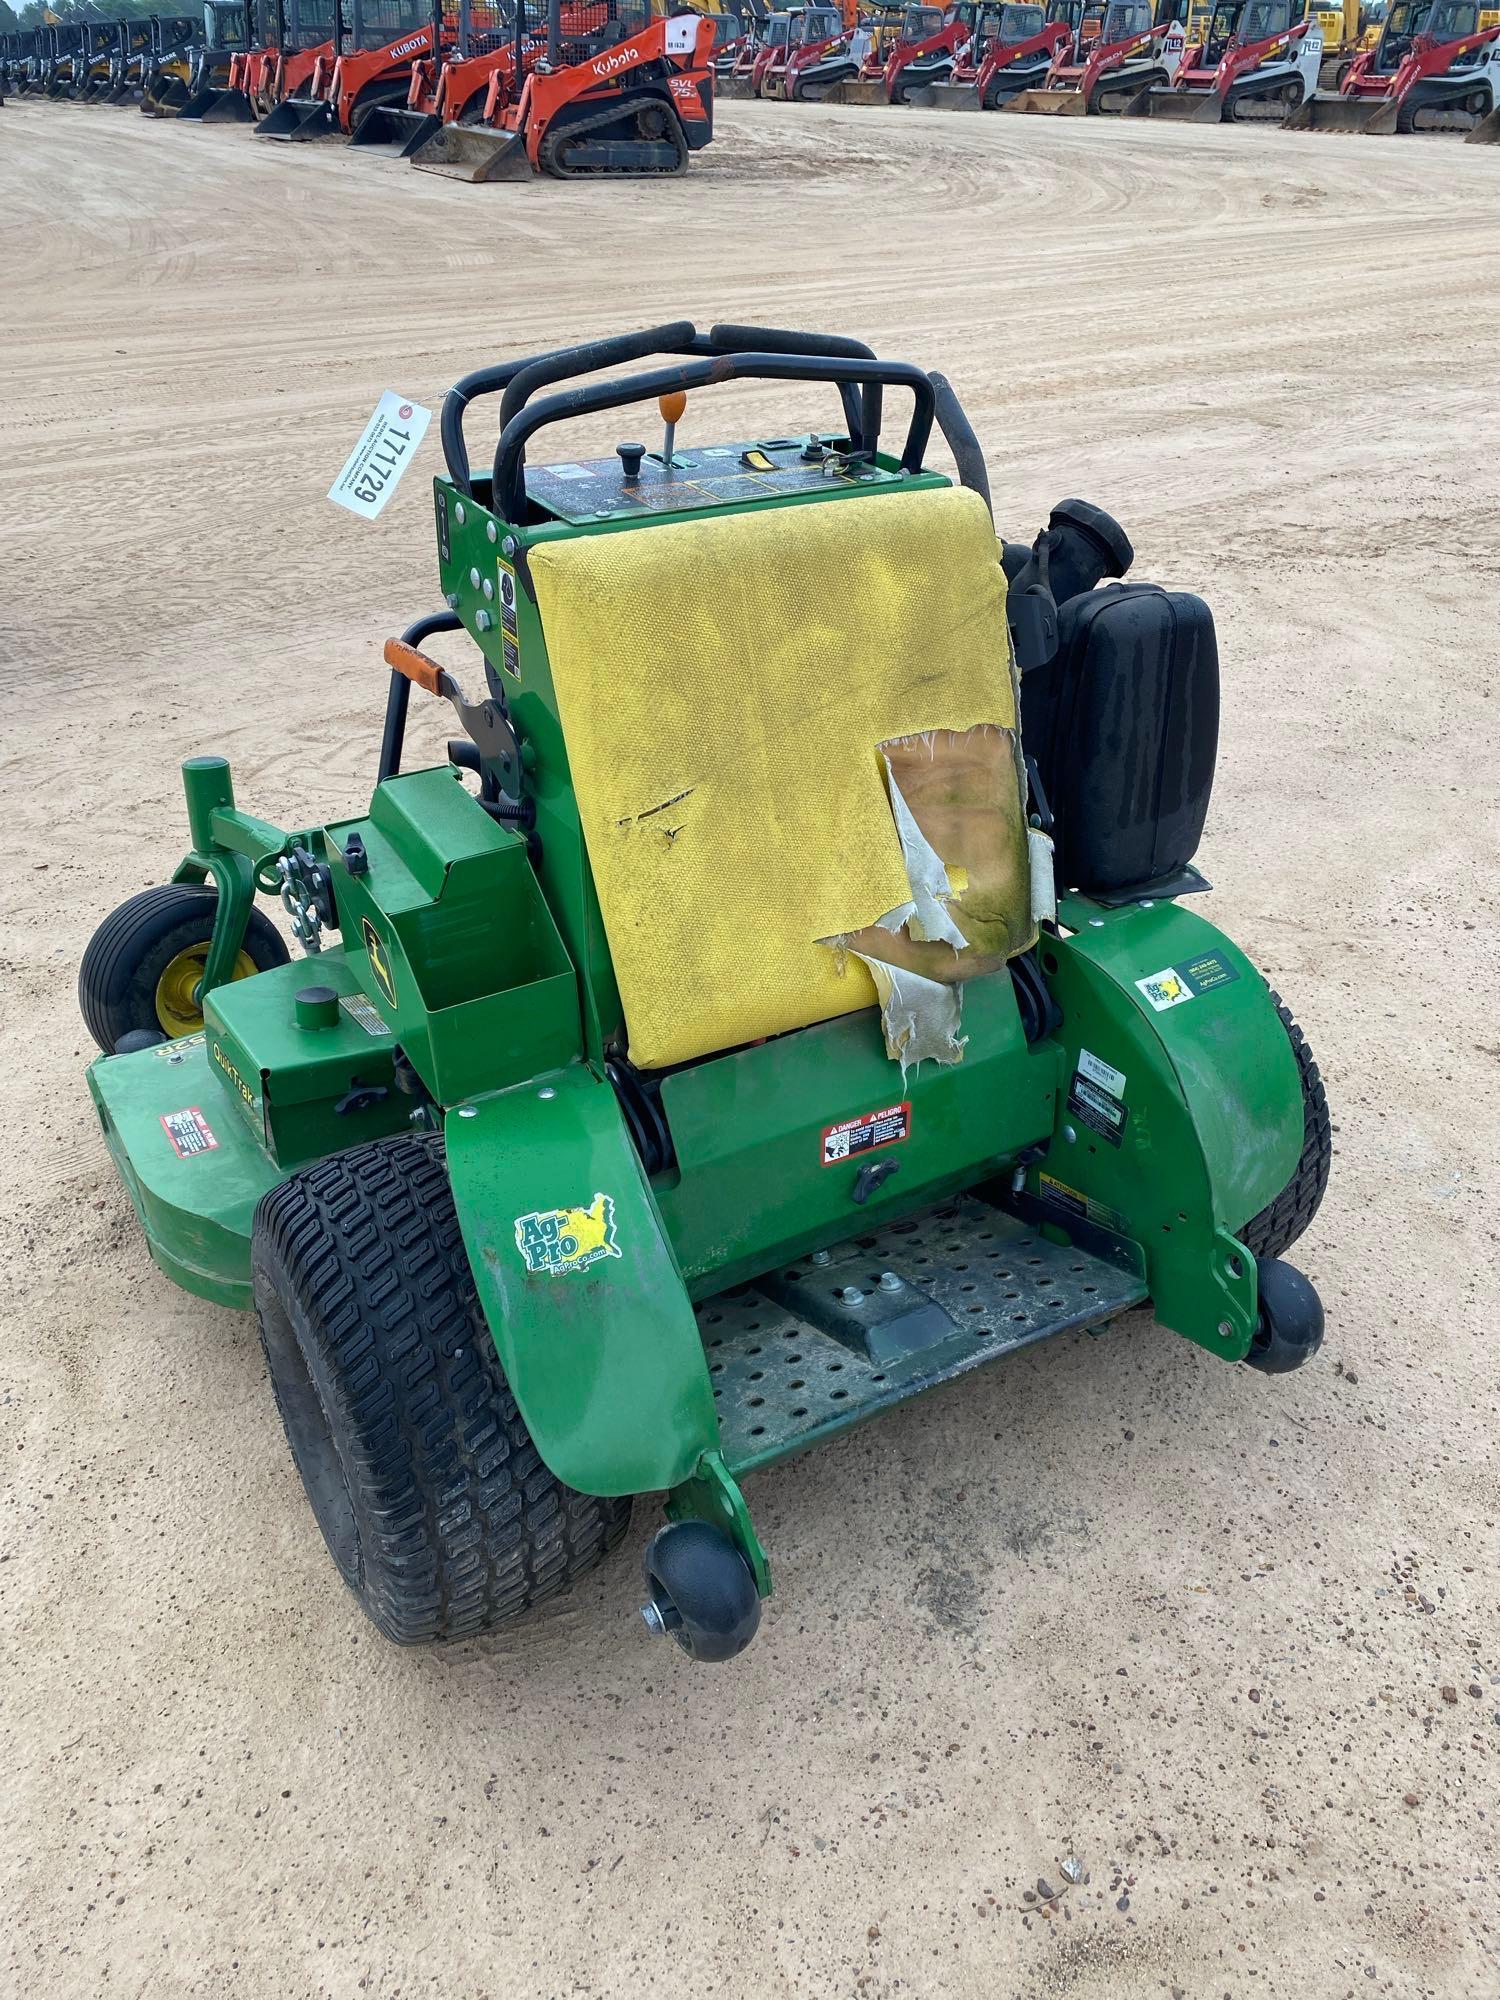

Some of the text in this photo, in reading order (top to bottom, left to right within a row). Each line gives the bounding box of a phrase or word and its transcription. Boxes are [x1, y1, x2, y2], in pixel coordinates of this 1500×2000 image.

[88, 53, 106, 65] DEERE
[127, 54, 144, 65] DEERE
[158, 52, 177, 64] DEERE
[390, 35, 428, 59] KUBOTA
[593, 48, 639, 75] Kubota
[669, 80, 695, 88] SVL
[361, 438, 377, 463] AUCTION
[346, 462, 363, 489] COMPANY
[354, 428, 411, 502] 171729
[157, 1035, 206, 1056] 52R
[213, 1042, 253, 1107] QuikTrak
[838, 1119, 862, 1132] DANGER
[877, 1106, 902, 1120] PELIGRO
[528, 1236, 578, 1270] Pro
[553, 1248, 607, 1275] AgProCo.com
